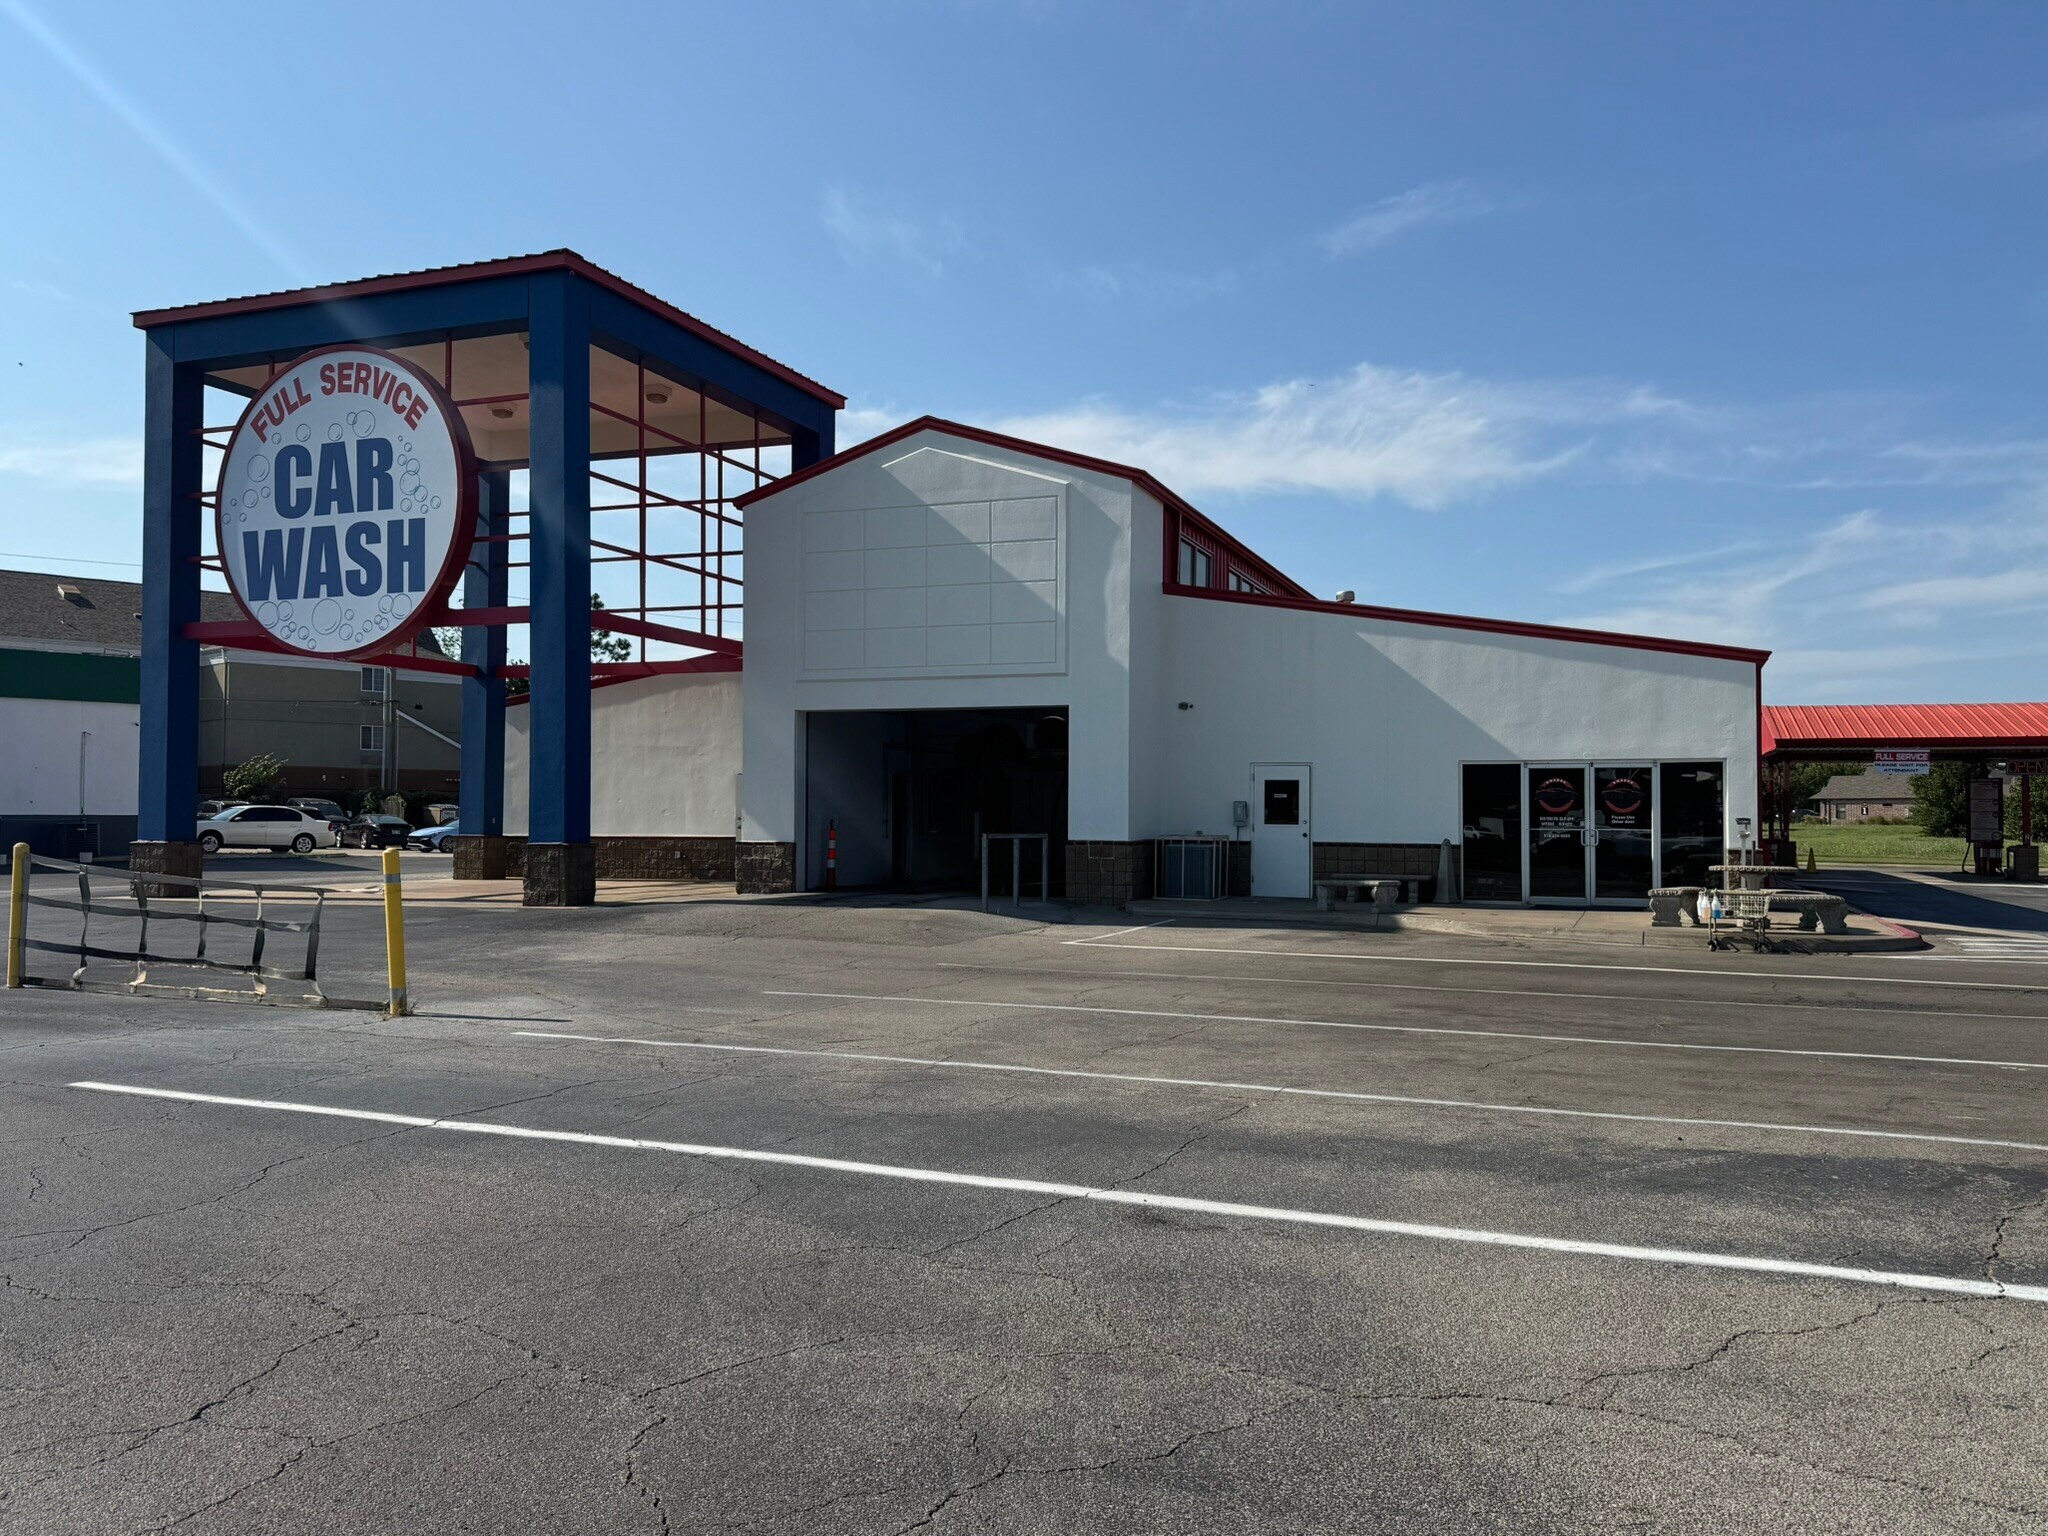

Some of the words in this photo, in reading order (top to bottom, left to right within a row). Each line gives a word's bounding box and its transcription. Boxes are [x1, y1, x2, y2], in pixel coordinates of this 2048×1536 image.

[250, 377, 312, 443] FULL
[320, 361, 429, 431] SERVICE
[274, 437, 394, 519] CAR
[243, 517, 426, 602] WASH
[1875, 753, 1894, 761] FULL
[1896, 753, 1928, 761] SERVICE
[2008, 760, 2047, 773] OPEN
